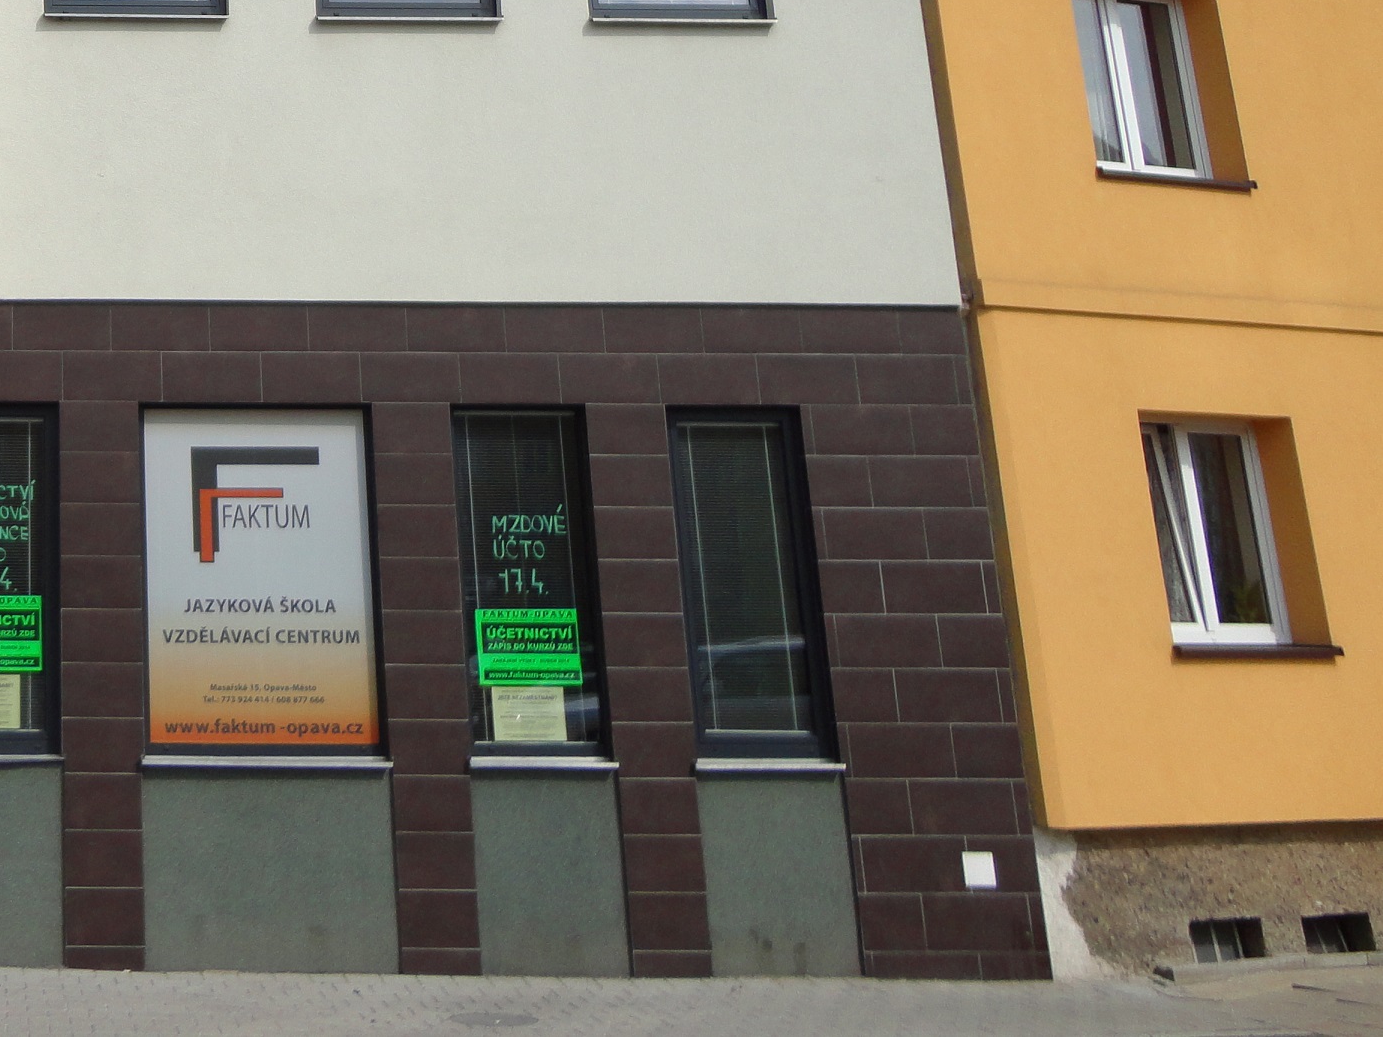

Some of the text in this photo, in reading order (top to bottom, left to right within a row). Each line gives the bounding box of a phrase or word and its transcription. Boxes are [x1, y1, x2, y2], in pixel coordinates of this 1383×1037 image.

[221, 504, 311, 529] FAKTUM
[491, 504, 567, 534] MZDOVÉ
[493, 534, 546, 560] ÚČTO
[498, 568, 549, 595] 17.4.
[184, 596, 337, 614] JAZYKOVÁ ŠKOLA
[162, 626, 361, 644] VZDĚLÁVACÍ CENTRUM
[486, 625, 572, 640] ÚČETNICTVÍ
[488, 640, 512, 650] ZÁPIS
[513, 642, 526, 651] DO
[557, 642, 574, 650] ZDE
[210, 682, 248, 692] Masařská
